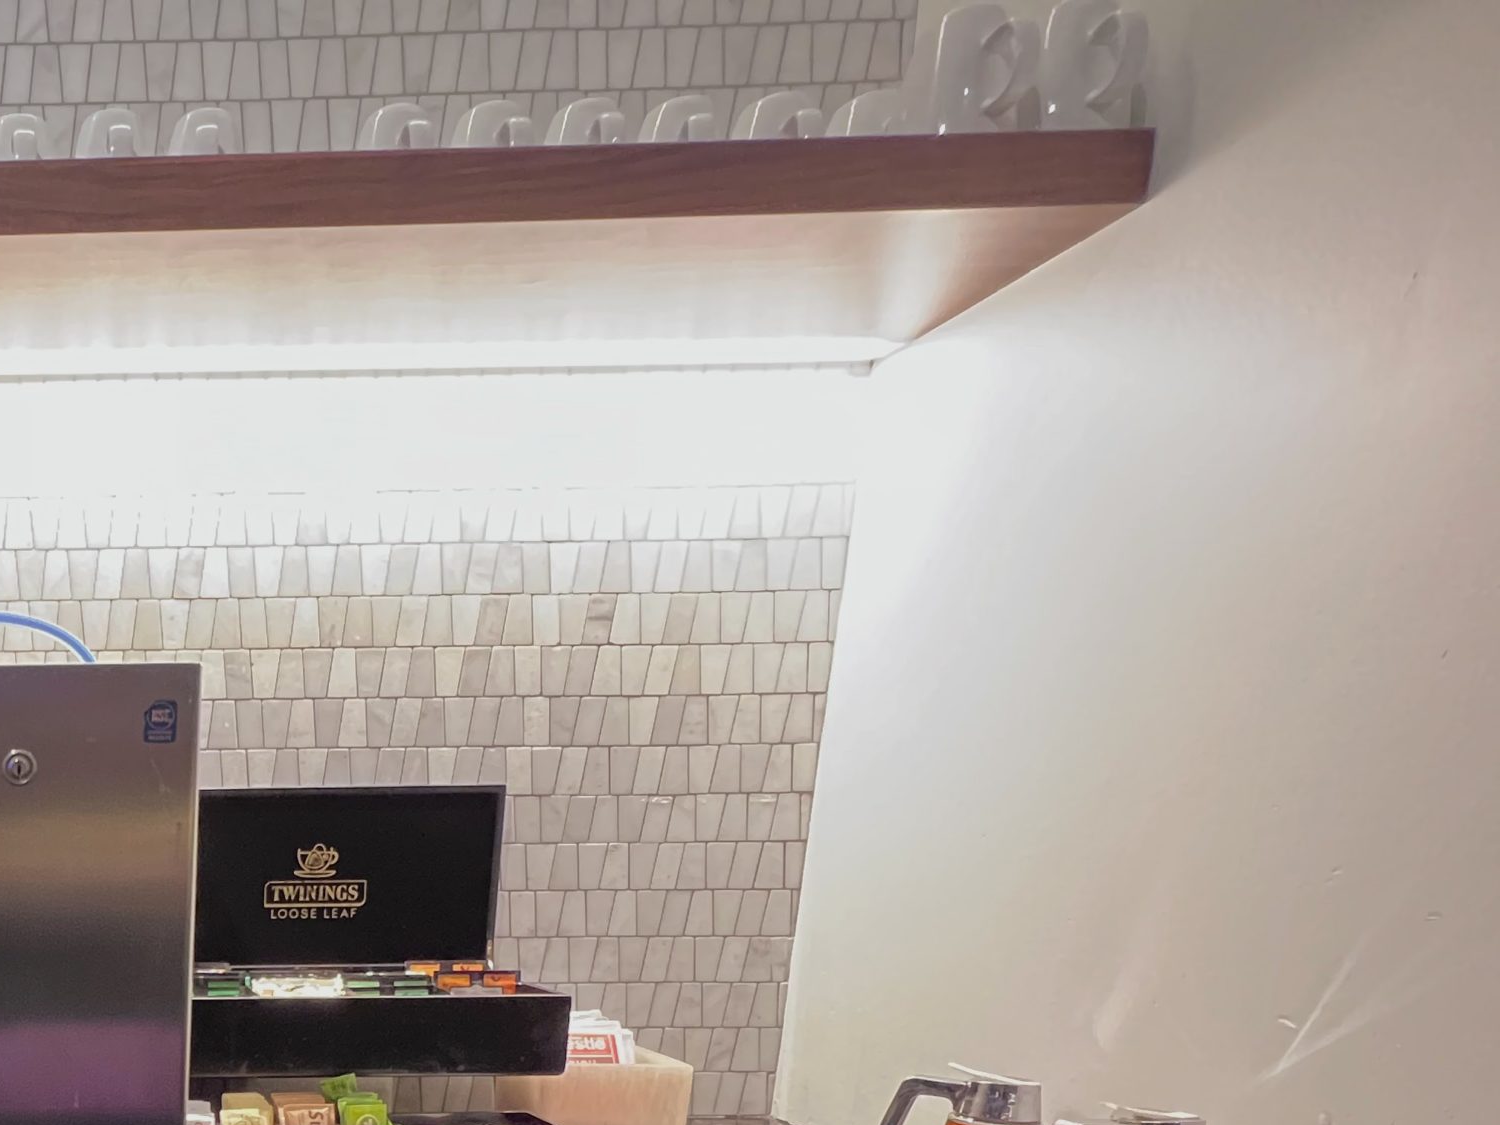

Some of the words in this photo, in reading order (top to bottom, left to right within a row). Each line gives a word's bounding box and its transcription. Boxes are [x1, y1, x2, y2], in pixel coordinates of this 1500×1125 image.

[271, 884, 359, 901] TWININGS
[270, 908, 317, 919] LOOSE
[323, 907, 358, 919] LEAF
